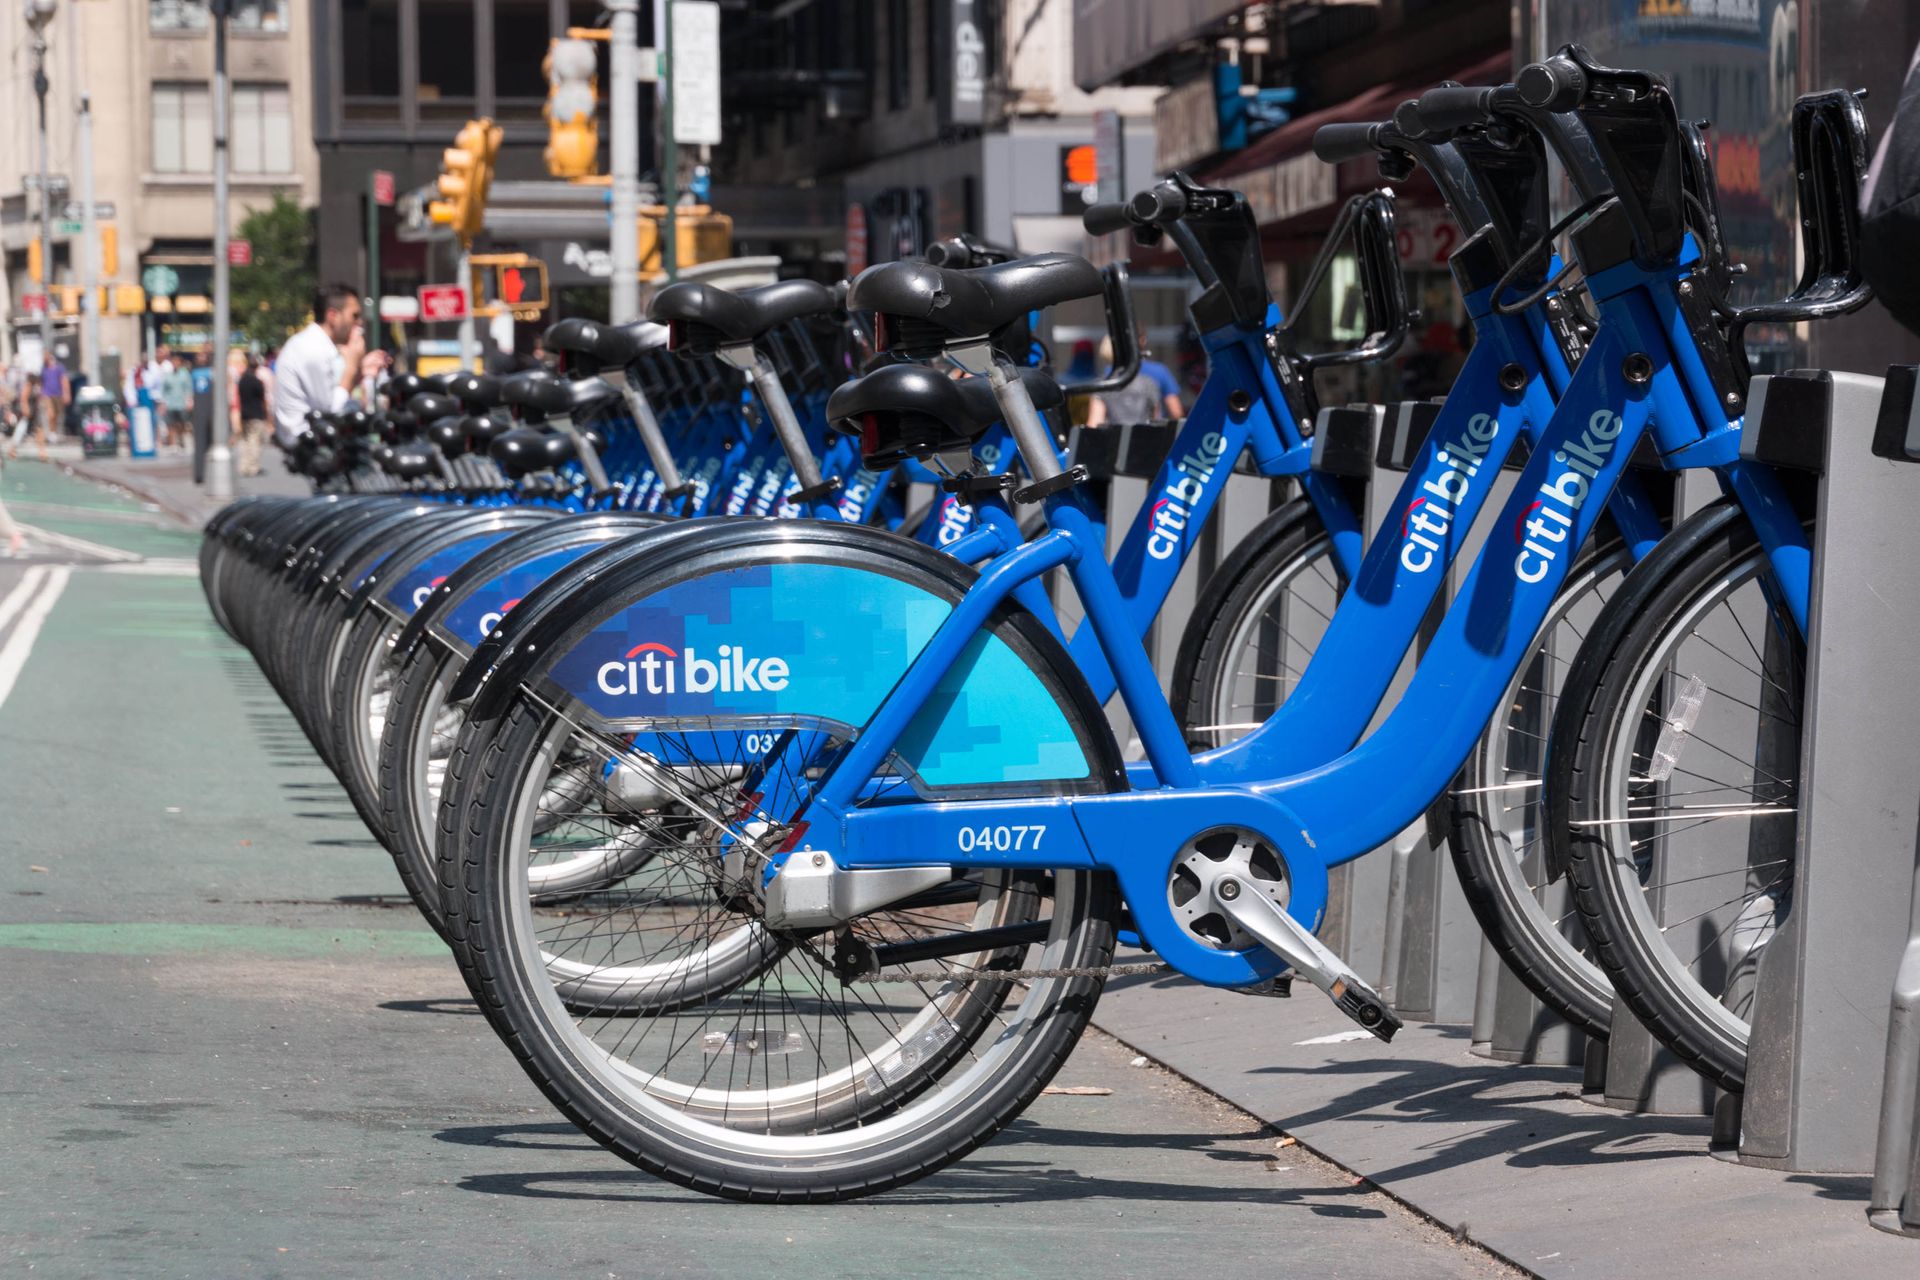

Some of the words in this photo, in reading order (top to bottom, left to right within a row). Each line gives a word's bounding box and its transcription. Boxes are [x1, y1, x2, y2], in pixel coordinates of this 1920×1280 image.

[1166, 431, 1228, 506] bike
[1423, 413, 1499, 506] bike
[1540, 409, 1623, 510] bike
[1147, 498, 1191, 560] citi
[1401, 497, 1454, 573] citi
[1515, 501, 1572, 583] citi
[597, 643, 677, 696] citi
[684, 644, 790, 693] bike
[958, 826, 1046, 852] 04077
